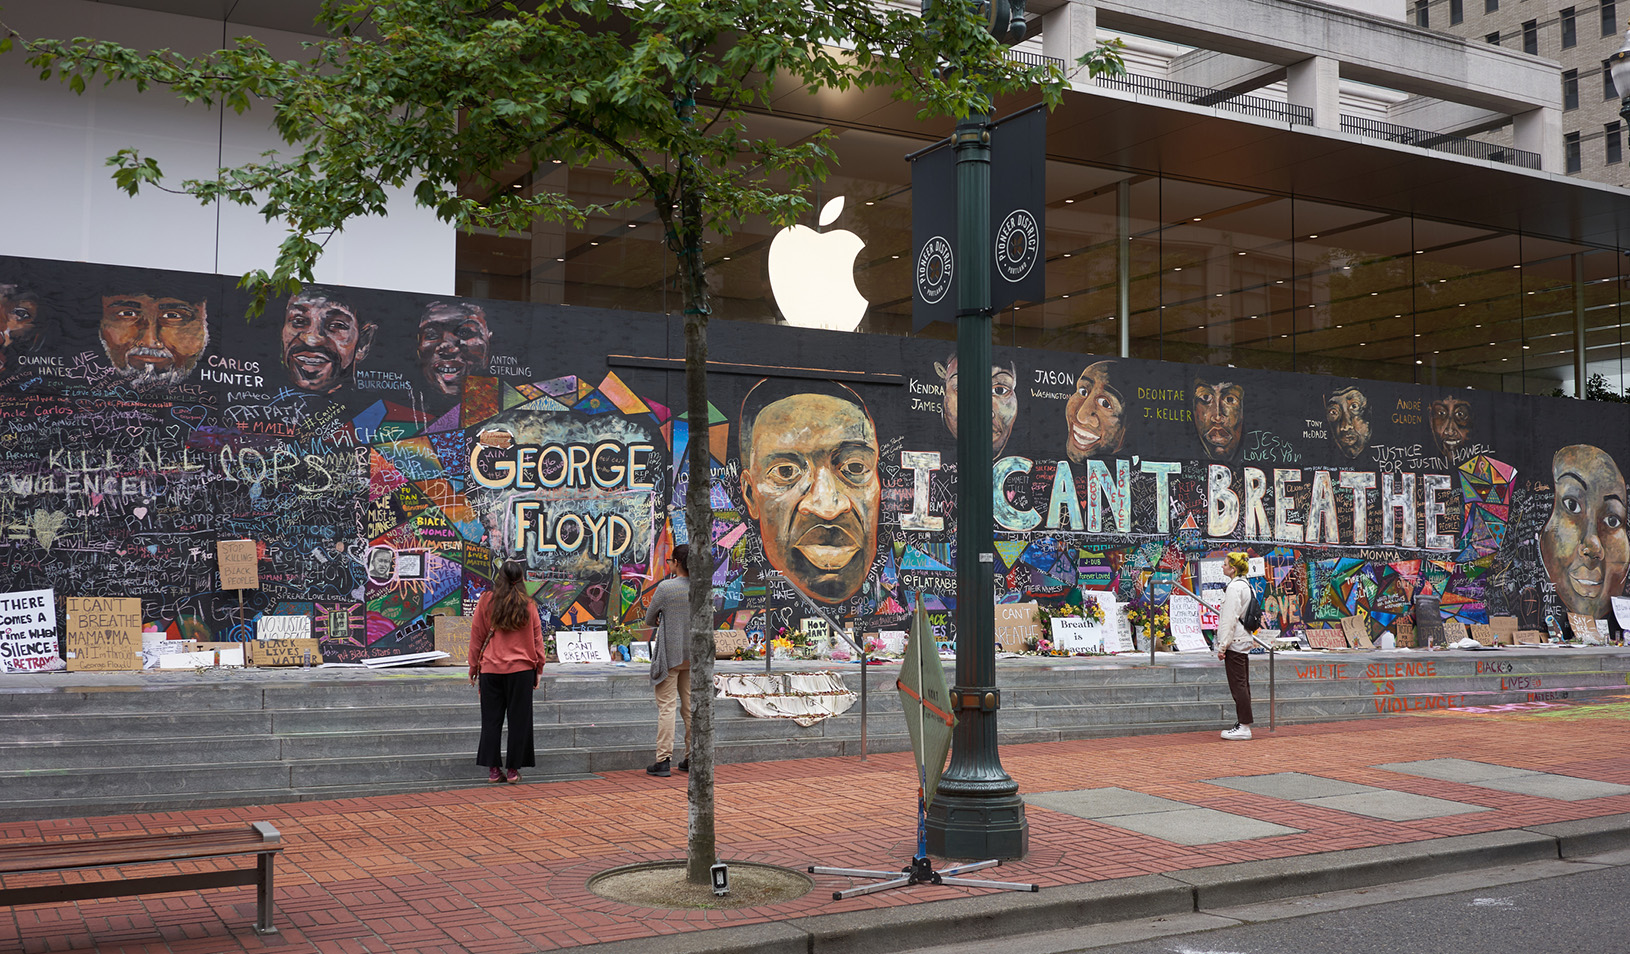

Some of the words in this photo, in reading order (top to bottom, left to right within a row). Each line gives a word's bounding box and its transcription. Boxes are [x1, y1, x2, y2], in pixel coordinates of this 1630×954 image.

[999, 217, 1016, 262] PIONEER
[1017, 214, 1036, 252] DISTRICT
[919, 243, 934, 284] PIONEER
[935, 241, 951, 276] DISTRICT
[1007, 262, 1027, 275] PORTLAND
[926, 285, 944, 297] PORTLAND
[208, 355, 260, 374] CARLOS
[490, 355, 518, 365] ANTON
[357, 370, 403, 380] MATTHEW
[489, 365, 532, 378] STERLING
[201, 369, 264, 387] HUNTER
[1034, 370, 1074, 386] JASON
[357, 380, 412, 390] BURROUGHS
[909, 378, 945, 396] KENDRA
[1030, 388, 1072, 400] WASHINGTON
[1138, 387, 1185, 401] DEONTAE
[34, 405, 74, 416] Carlos
[911, 398, 943, 413] JAMES
[1143, 407, 1153, 418] J.
[1156, 408, 1193, 422] KELLER
[1391, 413, 1422, 425] GLADEN
[1305, 419, 1322, 428] TONY
[1370, 444, 1423, 463] JUSTICE
[1379, 461, 1403, 474] FOR
[1406, 456, 1449, 471] JUSTIN
[1453, 443, 1496, 466] HOWELL
[49, 447, 124, 473] KILL
[138, 445, 206, 472] ALL
[220, 443, 333, 493] COPS
[470, 443, 654, 489] GEORGE
[710, 461, 738, 477] UMAN
[1101, 473, 1117, 503] THE
[1178, 481, 1196, 492] RIP
[901, 450, 945, 531] I
[993, 455, 1181, 533] CAN'T
[1208, 464, 1454, 550] BREATHE
[1089, 471, 1098, 529] ABOLISH
[1196, 484, 1208, 507] GOD
[375, 499, 391, 509] WE
[368, 510, 387, 521] MUST
[420, 528, 455, 537] WOMEN
[515, 502, 632, 557] FLOYD
[222, 543, 245, 553] STOP
[225, 553, 254, 562] KILLING
[1361, 549, 1399, 560] MOMMA
[224, 567, 251, 575] BLACK
[1097, 572, 1110, 580] Loved
[227, 576, 255, 585] PEOPLE
[1540, 582, 1557, 593] VOTE
[772, 589, 796, 600] HATE
[1543, 594, 1557, 603] OUT
[1, 596, 45, 611] THERE
[69, 599, 79, 612] I
[82, 598, 127, 613] CAN'T
[1002, 608, 1031, 619] CAN'T
[1545, 605, 1562, 616] HATE
[38, 612, 47, 622] A
[79, 614, 140, 628] BREATHE
[258, 616, 276, 633] NO
[277, 616, 311, 632] JUSTICE
[807, 620, 827, 629] HOW
[1061, 619, 1094, 629] Breath
[28, 626, 57, 639] WHEN
[577, 632, 582, 642] I
[1073, 633, 1083, 641] is
[259, 640, 296, 648] BLACK
[272, 655, 318, 665] MATTR
[564, 651, 602, 661] BREATHE
[1295, 664, 1349, 679] WHITE
[1366, 661, 1437, 678] SILENCE
[1371, 680, 1395, 695] IS
[1501, 677, 1530, 690] LIVES
[1374, 695, 1465, 713] VIOLENCE!
